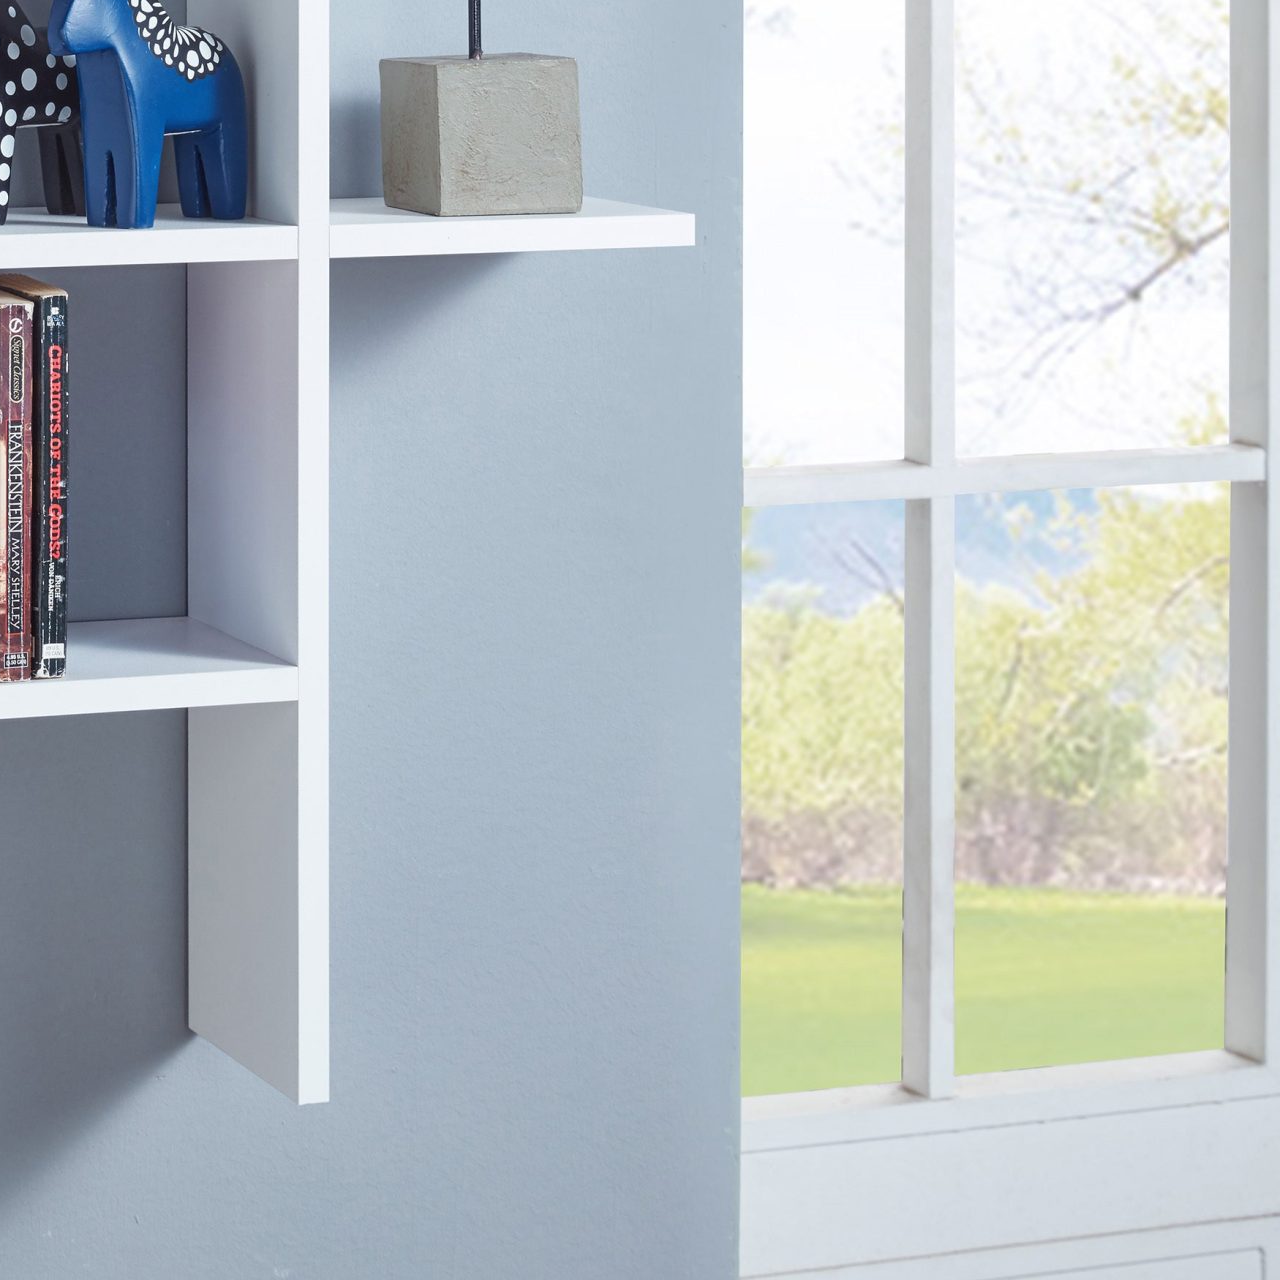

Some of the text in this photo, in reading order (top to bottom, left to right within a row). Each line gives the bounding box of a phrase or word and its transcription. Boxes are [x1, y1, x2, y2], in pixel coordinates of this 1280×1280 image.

[11, 337, 23, 401] Signet Classics
[48, 344, 63, 559] CHARIOTS OF THE GODS?
[8, 424, 24, 629] FRANKENSTEIN MARY SHELLEY
